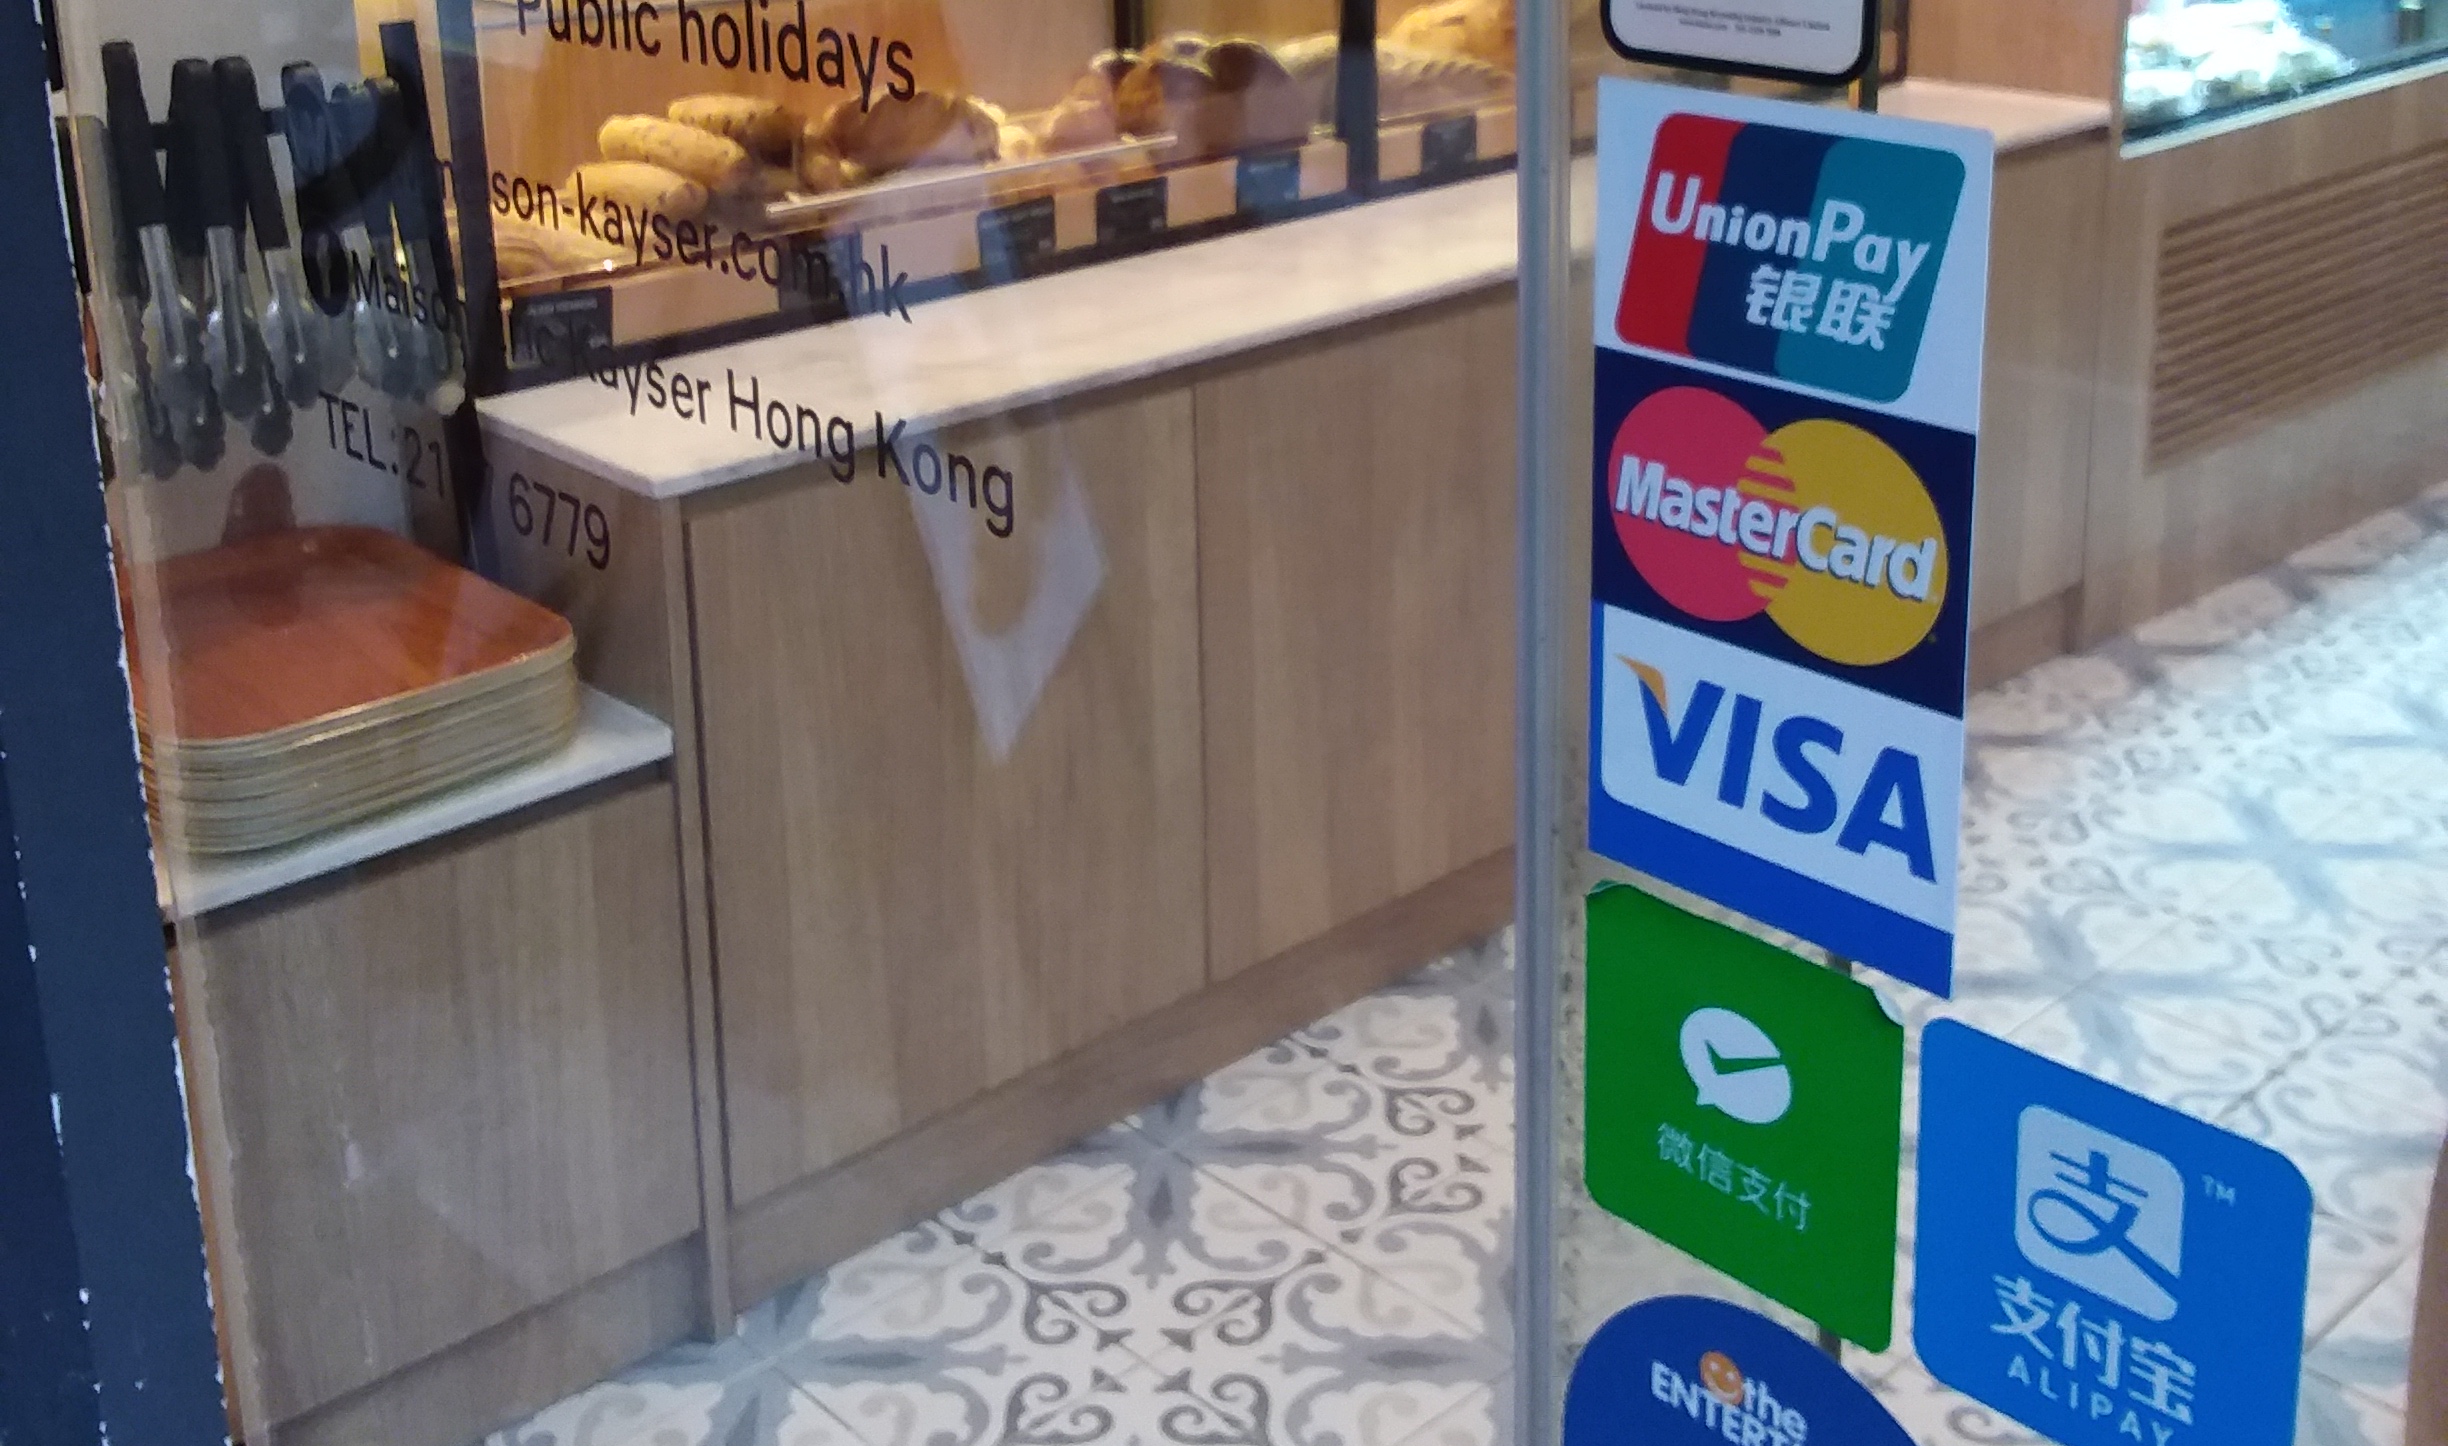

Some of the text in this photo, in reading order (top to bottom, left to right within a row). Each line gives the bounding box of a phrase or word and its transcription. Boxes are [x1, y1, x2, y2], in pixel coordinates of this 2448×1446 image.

[517, 0, 916, 113] Public holidays
[491, 170, 913, 324] son-kayser.com.hk
[1650, 169, 1930, 299] UnionPay
[1744, 263, 1897, 352] 银联
[350, 249, 448, 332] Maiso
[727, 367, 856, 484] Hong
[875, 411, 1014, 538] Kong
[507, 472, 611, 570] 6779
[1615, 455, 1938, 603] MasterCard
[1616, 653, 1937, 884] VISA
[1656, 1122, 1812, 1232] 微信支付
[1742, 1376, 1808, 1443] the
[1989, 1273, 2197, 1426] 支付宝
[2007, 1354, 2174, 1446] ALIPAY
